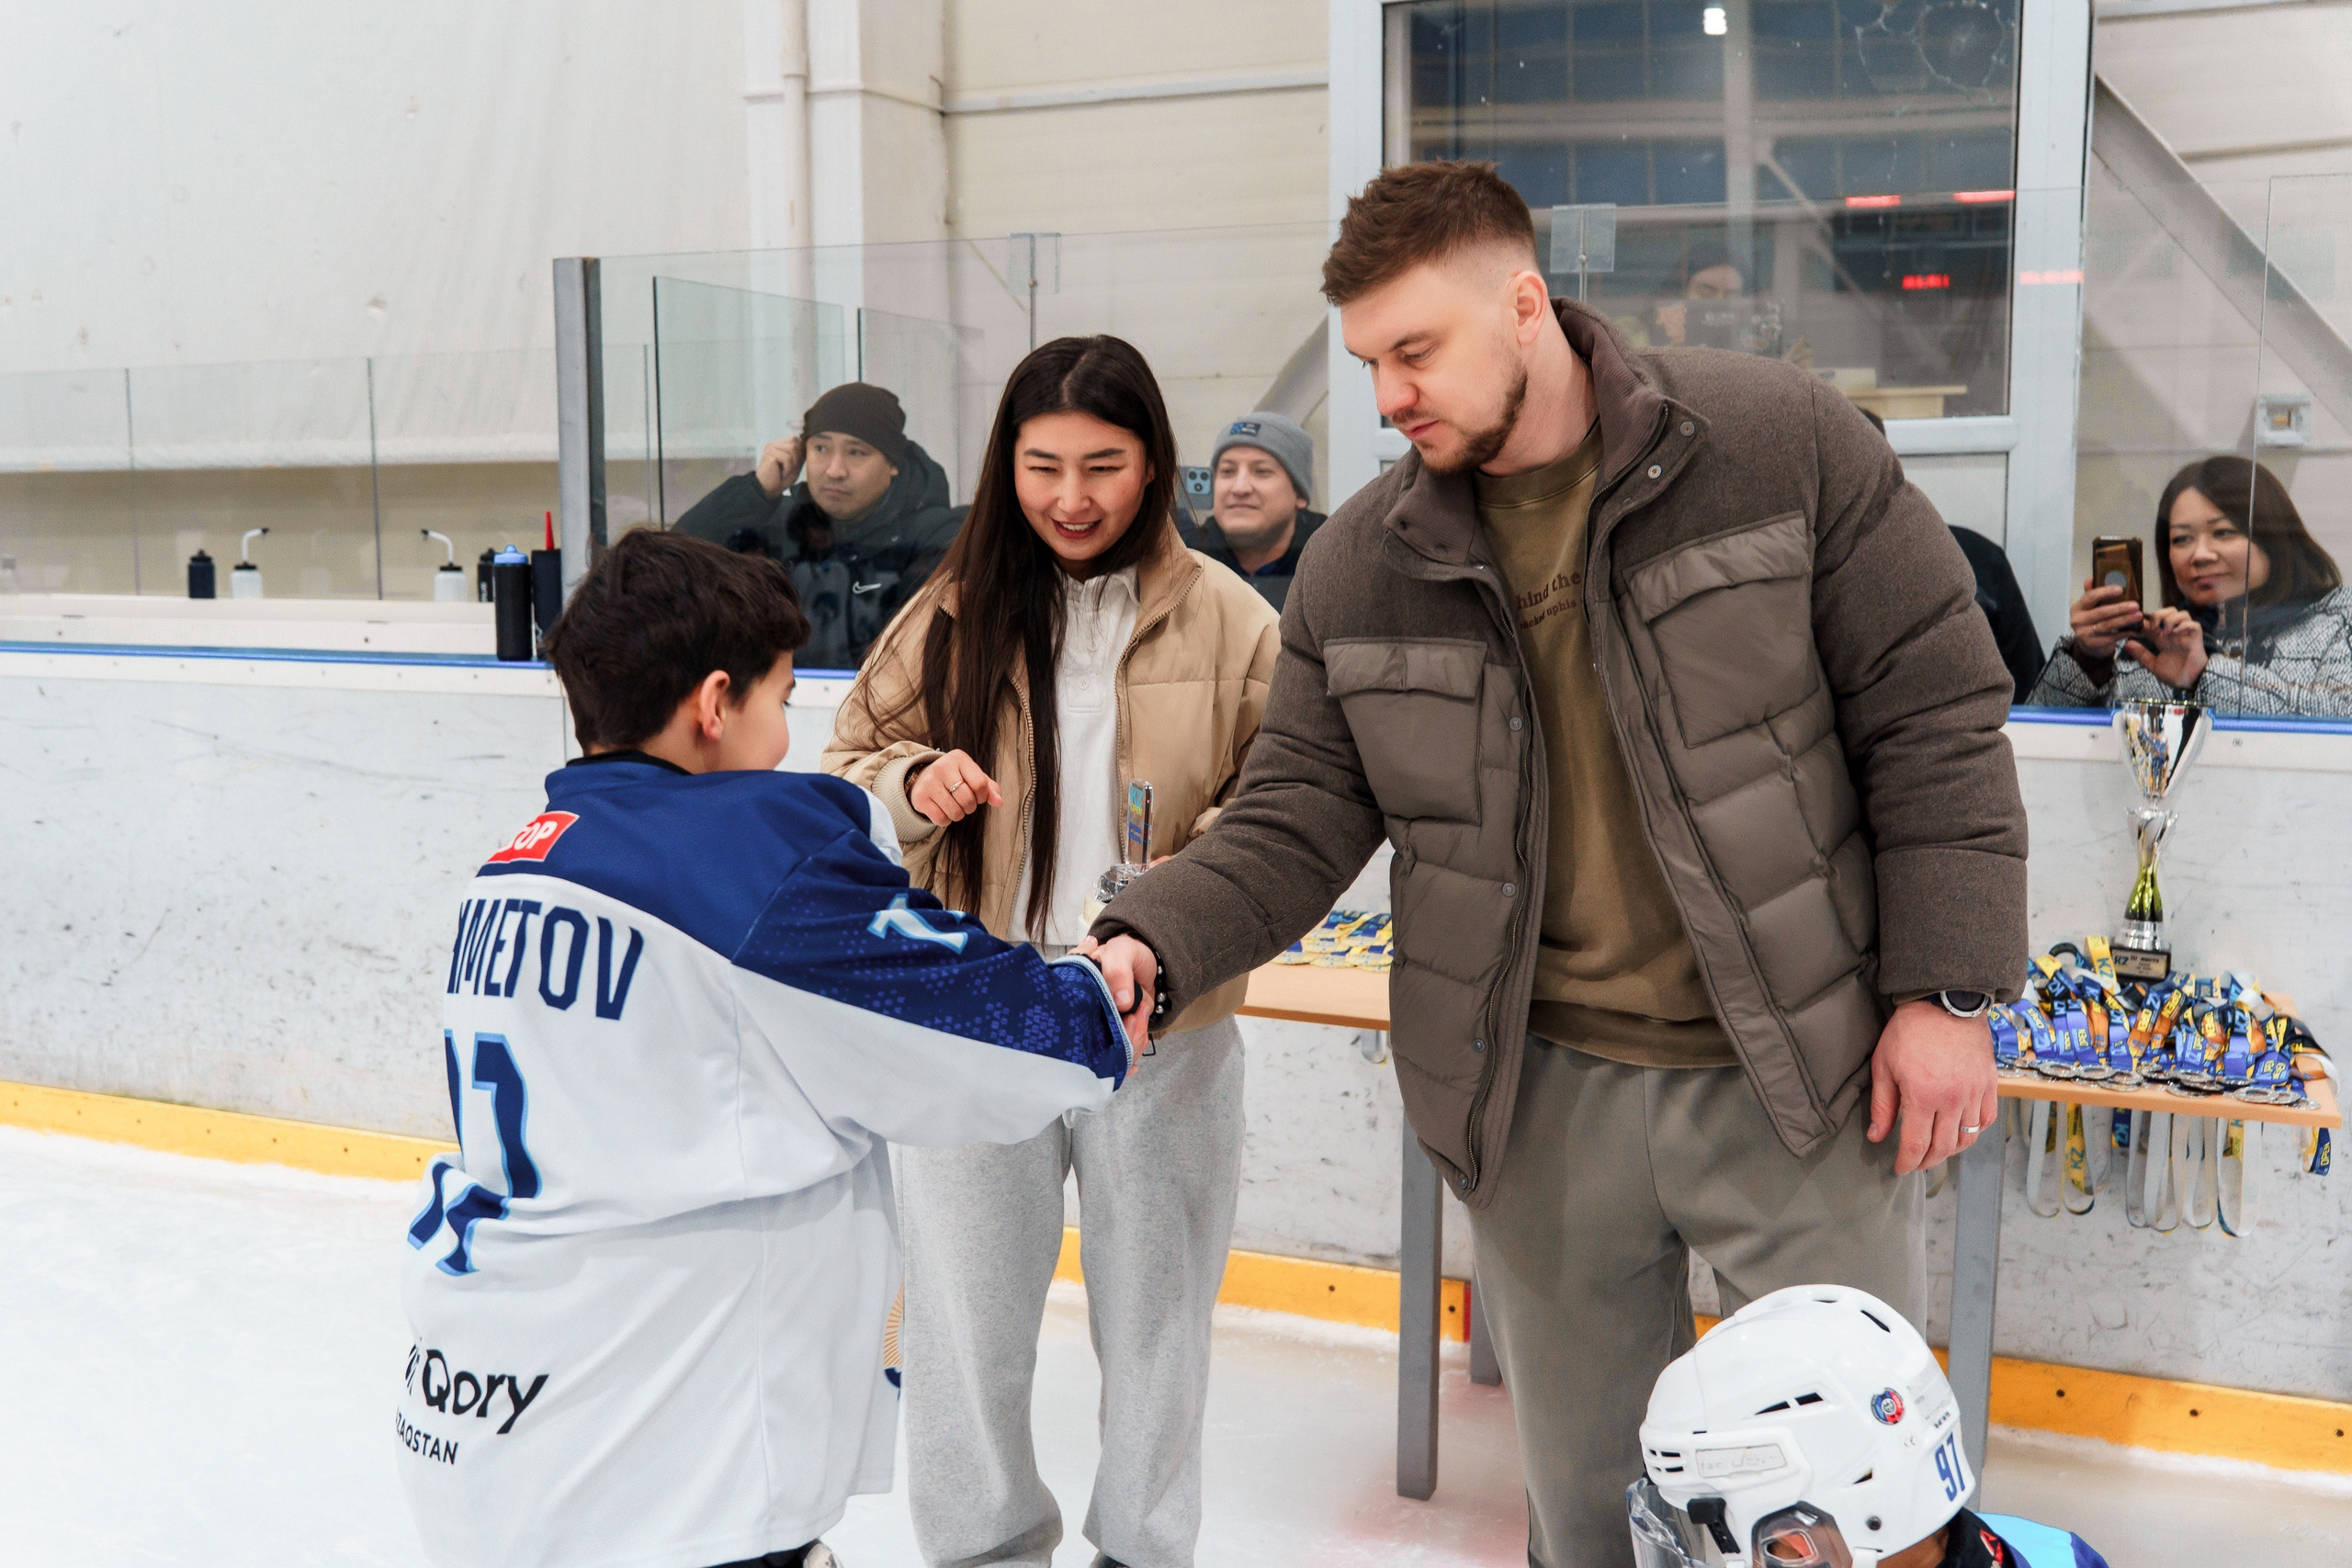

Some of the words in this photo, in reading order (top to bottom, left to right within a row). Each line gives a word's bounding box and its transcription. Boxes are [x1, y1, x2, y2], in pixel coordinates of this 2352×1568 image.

[1552, 572, 1582, 592] the
[2114, 955, 2129, 965] KZ
[422, 1348, 549, 1435] Qory
[1934, 1430, 1966, 1502] 97
